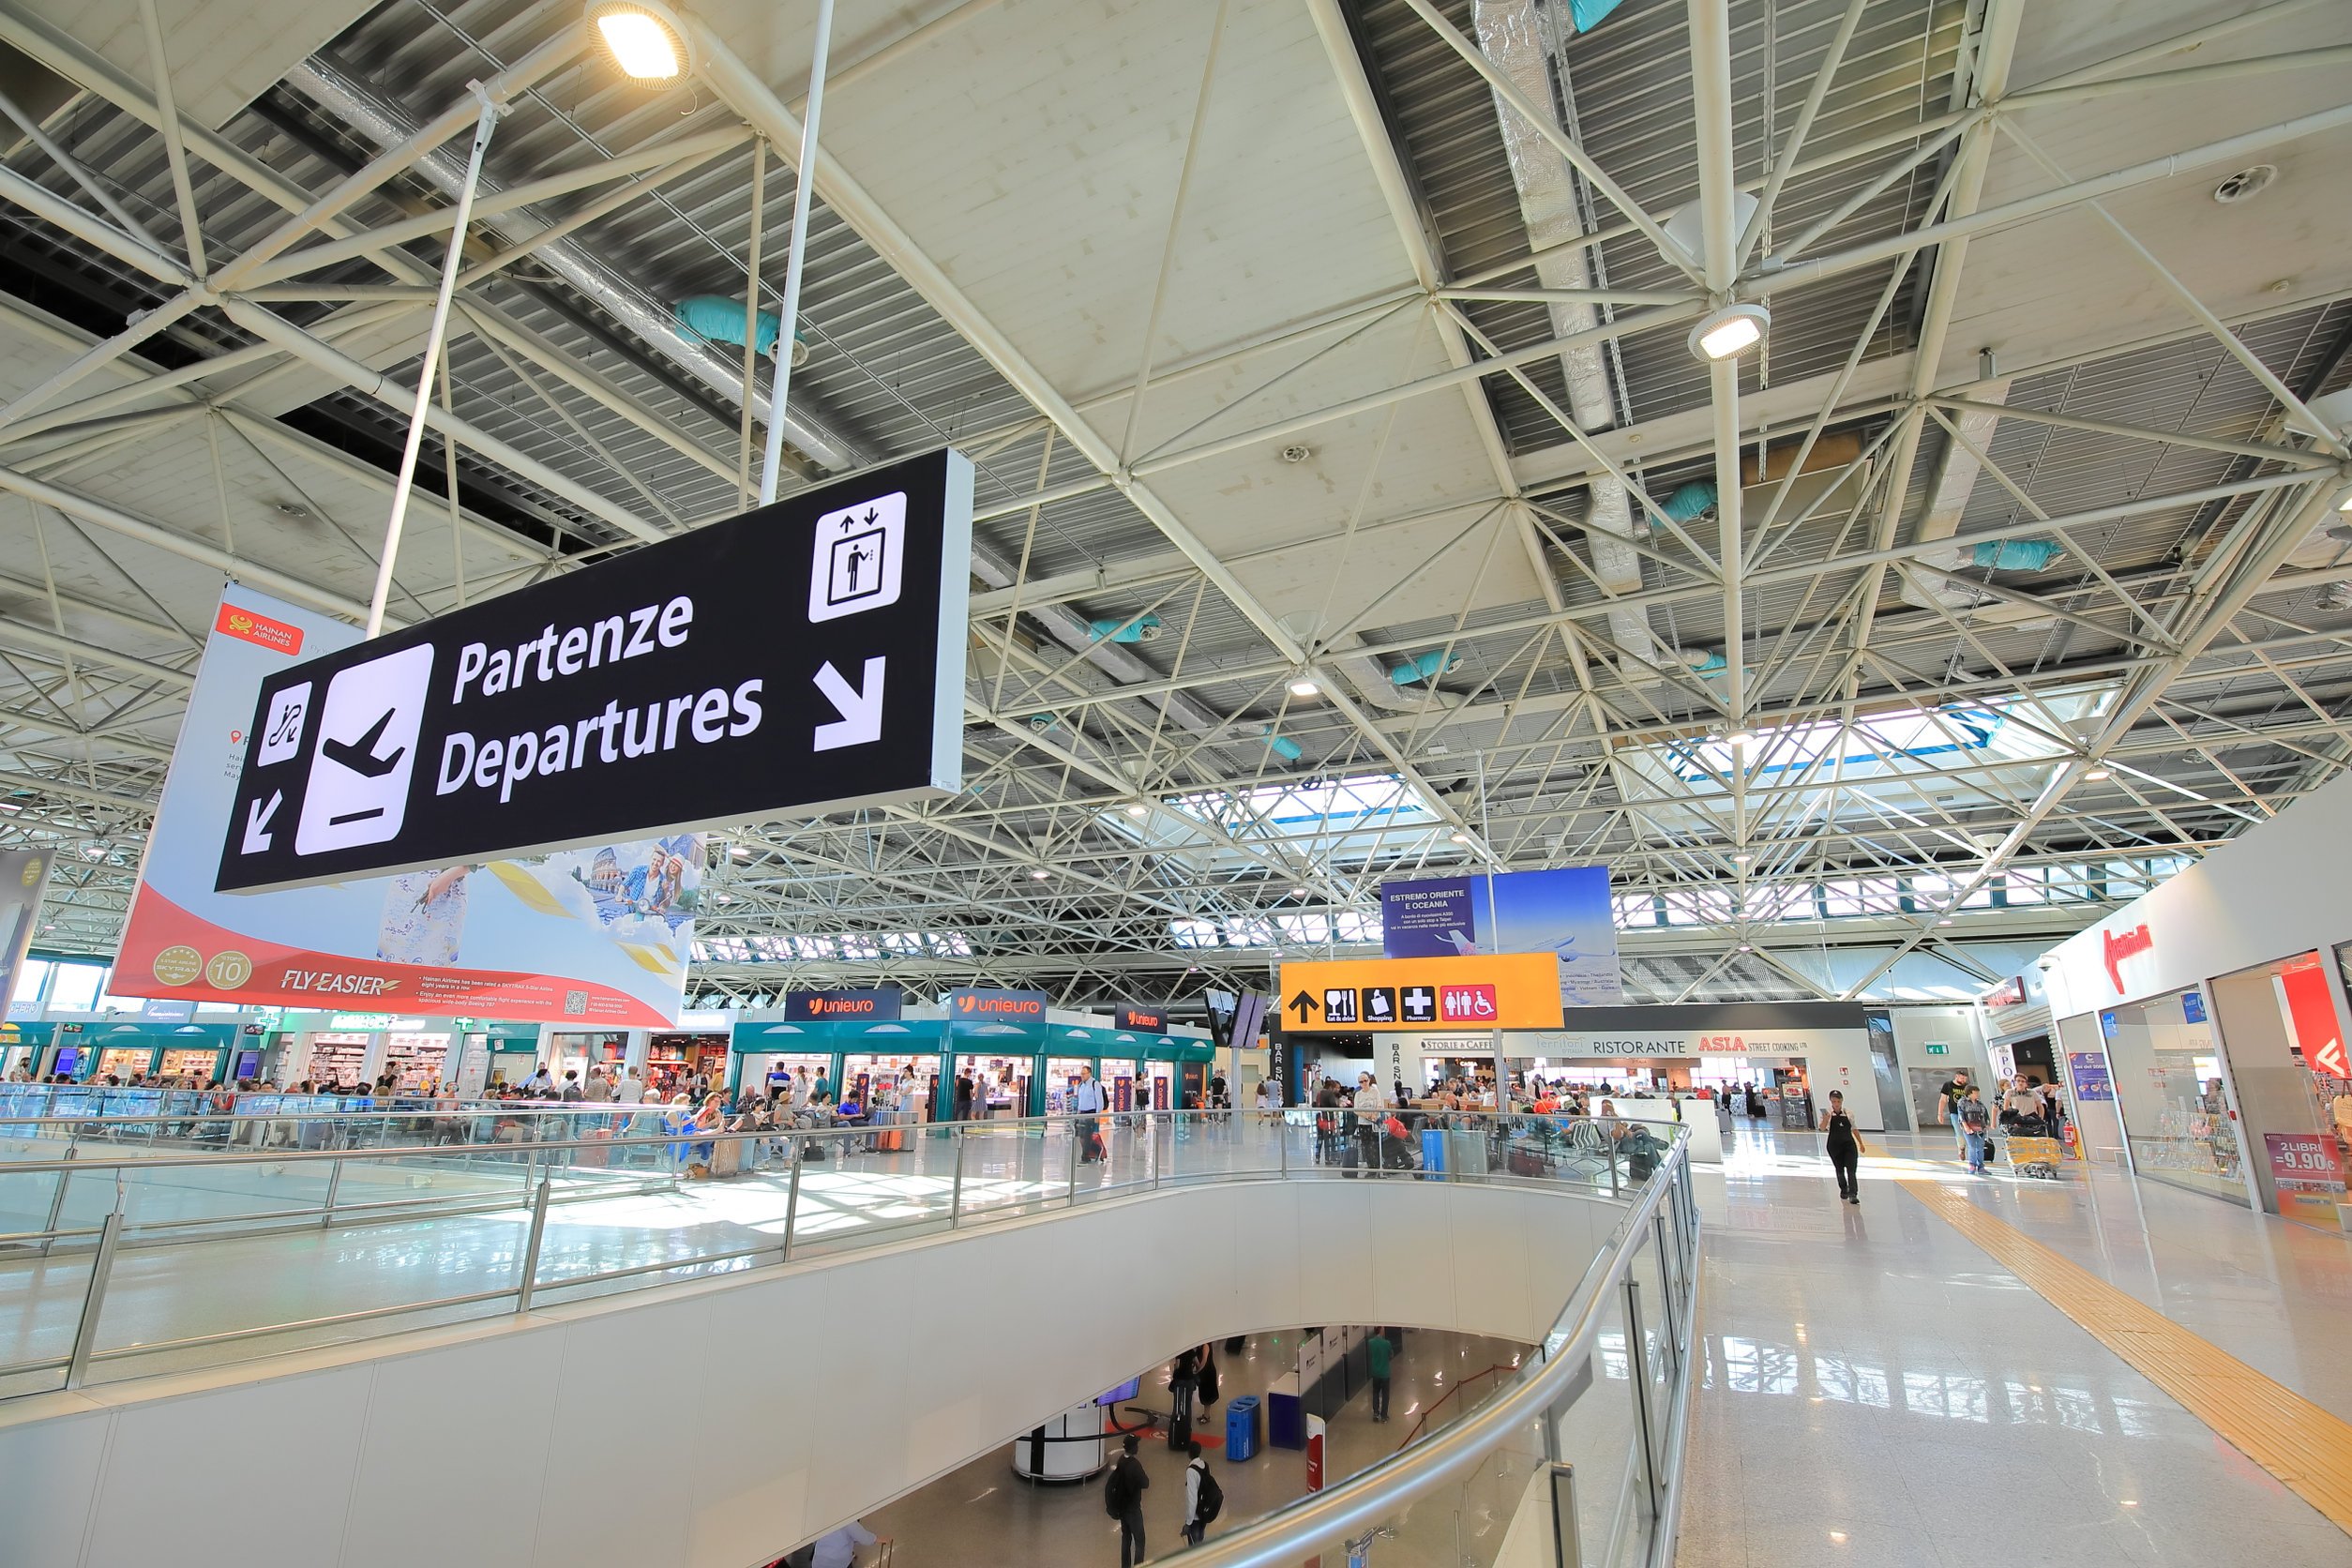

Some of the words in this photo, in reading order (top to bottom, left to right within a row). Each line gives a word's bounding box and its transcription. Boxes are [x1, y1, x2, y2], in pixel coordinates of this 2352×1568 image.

[253, 630, 291, 647] AIRLINES
[255, 623, 294, 640] HAINAN
[452, 596, 694, 704] Partenze
[436, 678, 763, 804] Departures
[1390, 892, 1428, 902] ESTREMO
[1429, 889, 1465, 899] ORIENTE
[1411, 900, 1448, 910] OCEANIA
[156, 964, 199, 973] SKYTRAX
[215, 961, 242, 982] 10
[281, 969, 318, 990] FLY
[317, 972, 386, 996] EASIER
[823, 997, 873, 1013] unieuro
[978, 996, 1040, 1014] unieuro
[1135, 1012, 1158, 1028] unieuro
[1426, 1040, 1458, 1049] STORIE
[1593, 1040, 1686, 1054] RISTORANTE
[1697, 1036, 1747, 1052] ASIA
[1748, 1043, 1771, 1052] STREET
[1772, 1042, 1799, 1052] COOKING
[1274, 1043, 1283, 1063] BAR
[1392, 1043, 1400, 1064] BAR
[2288, 1142, 2322, 1153] LIBRI
